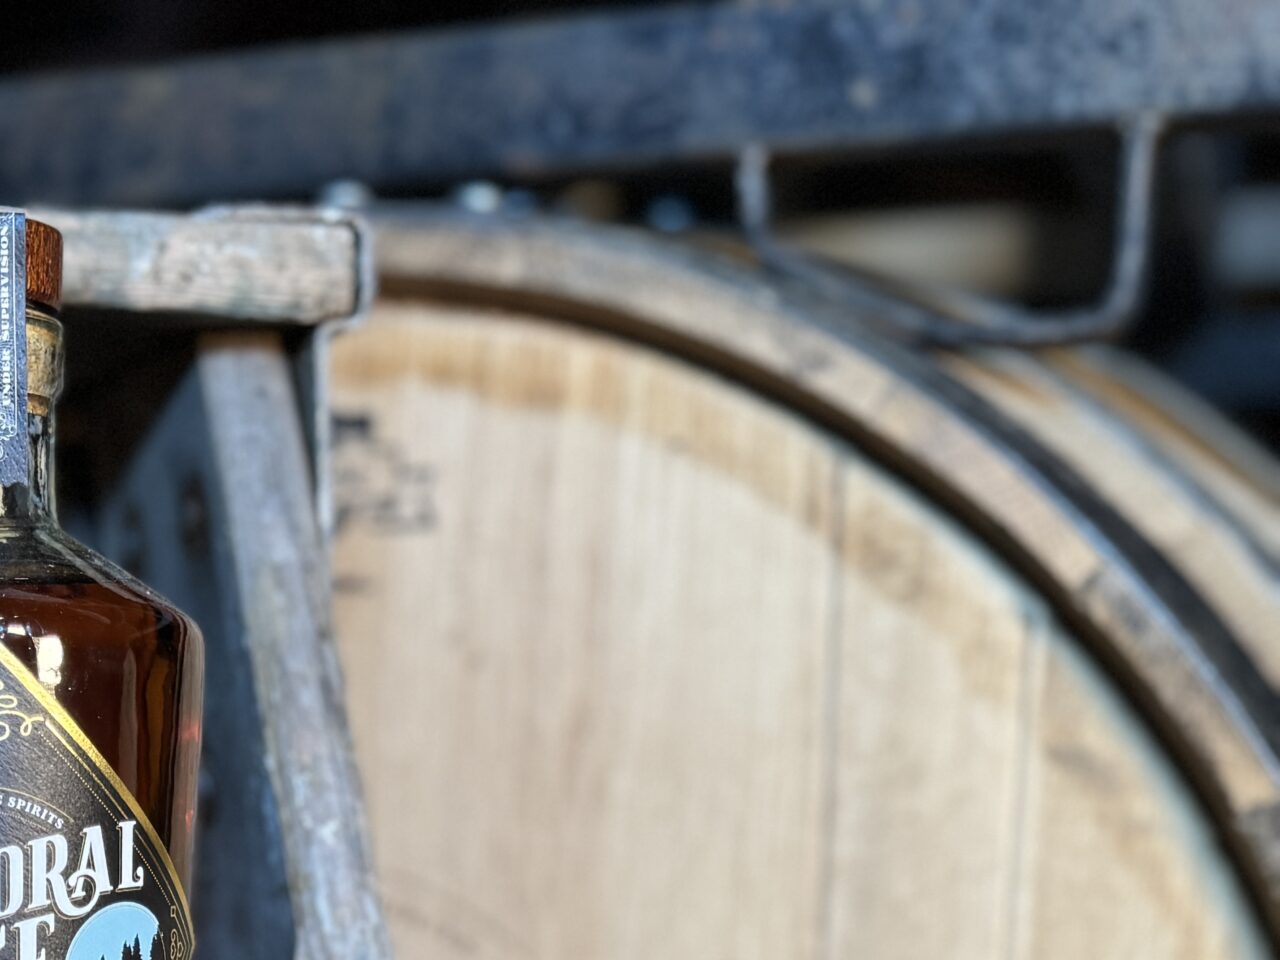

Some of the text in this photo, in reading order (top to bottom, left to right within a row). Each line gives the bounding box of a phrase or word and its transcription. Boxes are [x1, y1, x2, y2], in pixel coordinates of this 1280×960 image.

[0, 224, 11, 406] UNDER SUPERVISION
[7, 796, 64, 829] SPIRITS
